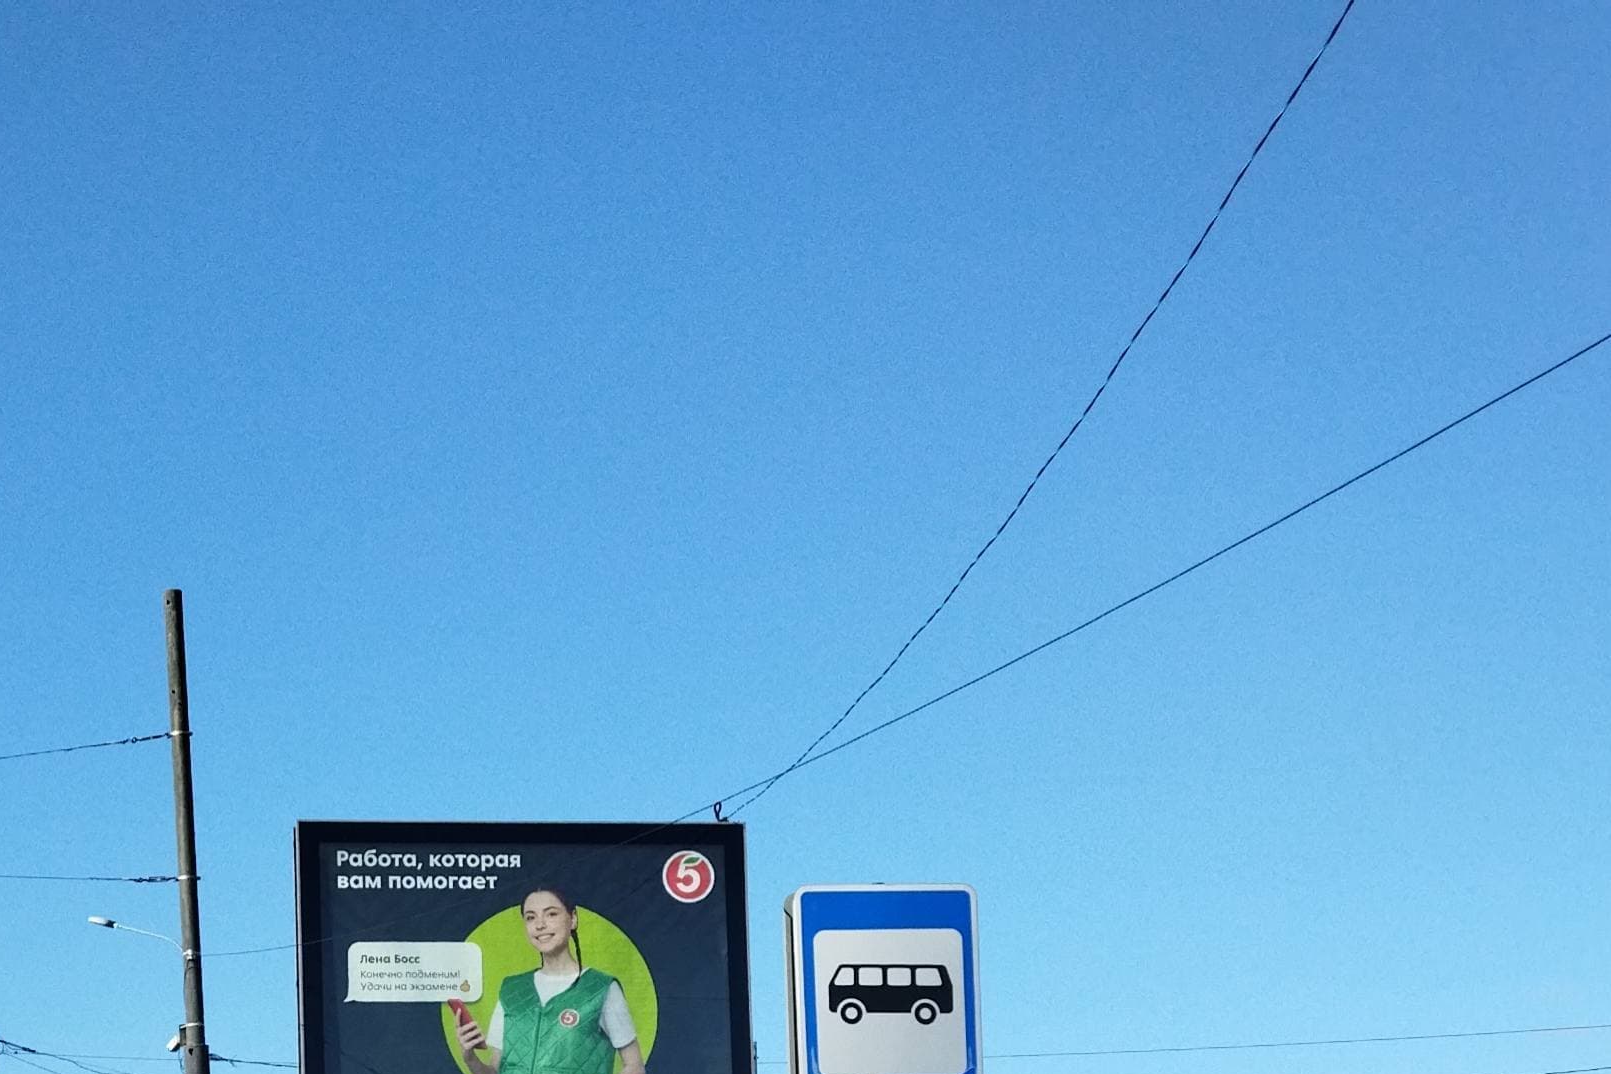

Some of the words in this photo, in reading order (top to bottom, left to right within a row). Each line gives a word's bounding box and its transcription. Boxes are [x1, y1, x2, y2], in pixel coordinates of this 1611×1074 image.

[336, 849, 423, 870] Работа,
[428, 853, 521, 872] которая
[337, 875, 382, 889] вам
[388, 875, 498, 890] помогает
[360, 954, 391, 964] Лена
[394, 954, 420, 964] Босс
[360, 970, 403, 979] Конечно
[360, 982, 392, 991] Удачи
